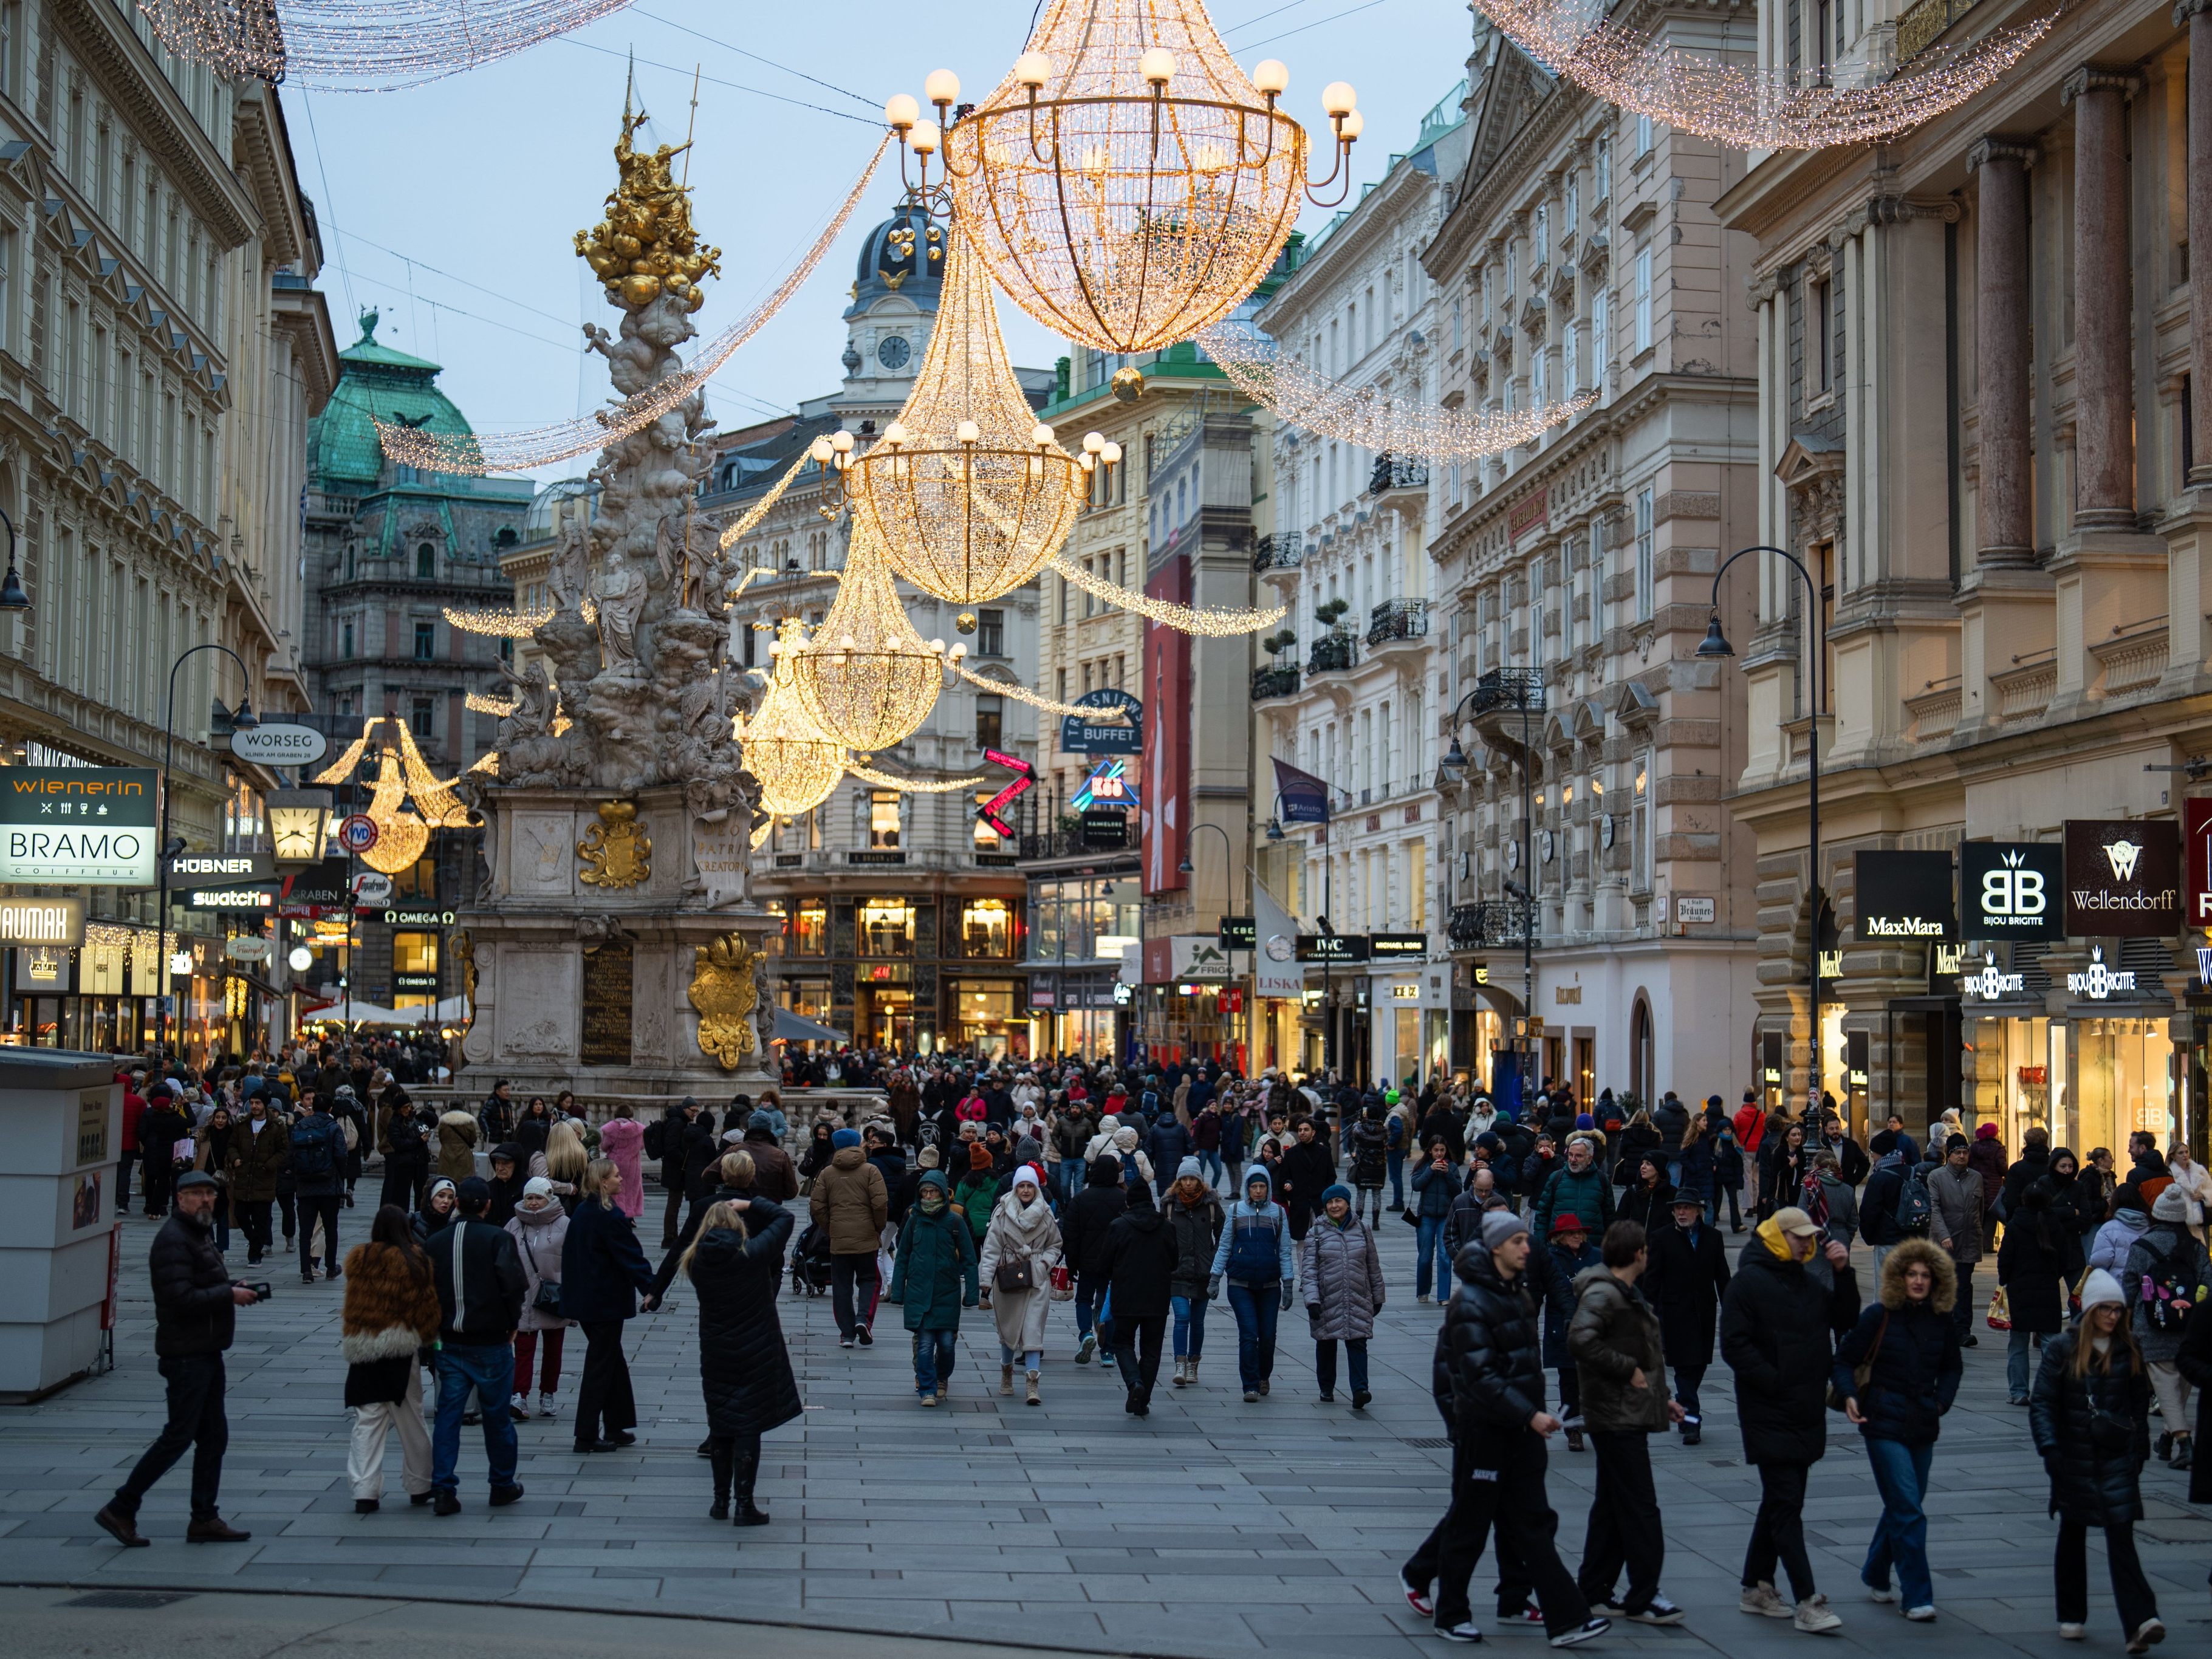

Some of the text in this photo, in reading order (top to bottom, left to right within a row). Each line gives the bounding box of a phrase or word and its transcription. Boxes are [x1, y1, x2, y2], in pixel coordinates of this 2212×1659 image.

[246, 734, 312, 747] WORSEG
[1084, 728, 1134, 741] BUFFET
[13, 778, 142, 796] wienerin
[1298, 804, 1321, 813] Aristo
[704, 822, 739, 836] DEO
[10, 833, 140, 860] BRAMO
[699, 842, 742, 855] PATRI
[15, 867, 134, 876] COIFFEUR
[173, 859, 252, 873] HÜBNER
[698, 860, 744, 872] CREATORI
[353, 875, 388, 894] Segafredo
[193, 891, 260, 906] swatch
[291, 889, 337, 901] GRABEN
[2071, 889, 2175, 910] Wellendorff
[281, 905, 310, 917] CAMPER
[399, 912, 439, 923] OMEGA
[0, 905, 67, 940] AUMAX
[1867, 917, 1943, 936] MaxMara
[1984, 916, 2043, 926] BIJOU BRIGITTE
[233, 943, 264, 957] Triumph
[1258, 977, 1301, 990] LISKA
